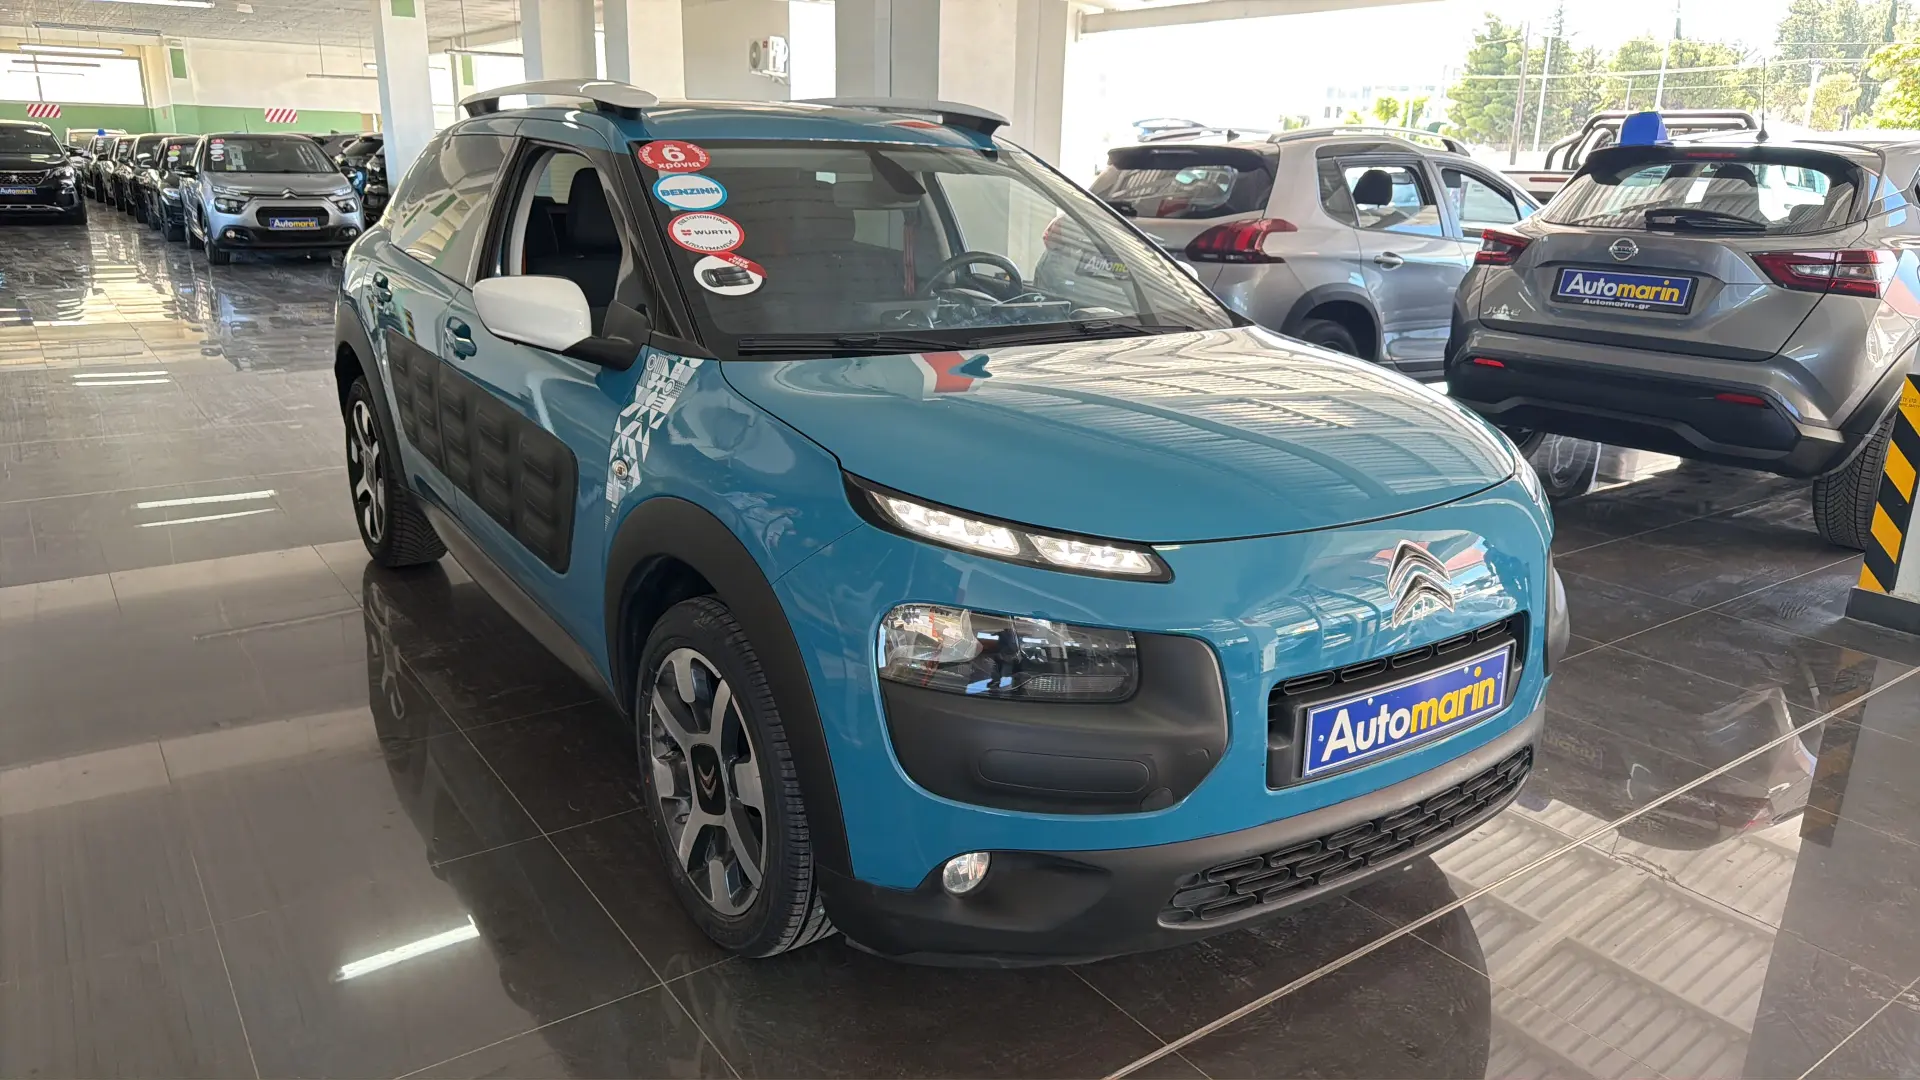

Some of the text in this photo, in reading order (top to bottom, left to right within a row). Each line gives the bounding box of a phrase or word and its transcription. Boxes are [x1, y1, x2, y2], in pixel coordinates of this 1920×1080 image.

[662, 146, 686, 162] 6
[657, 161, 701, 170] χρόνια
[274, 218, 316, 228] Automarin
[1566, 272, 1680, 302] Automarin
[1582, 298, 1651, 310] Automarin.gr
[1321, 666, 1496, 762] Automarin
